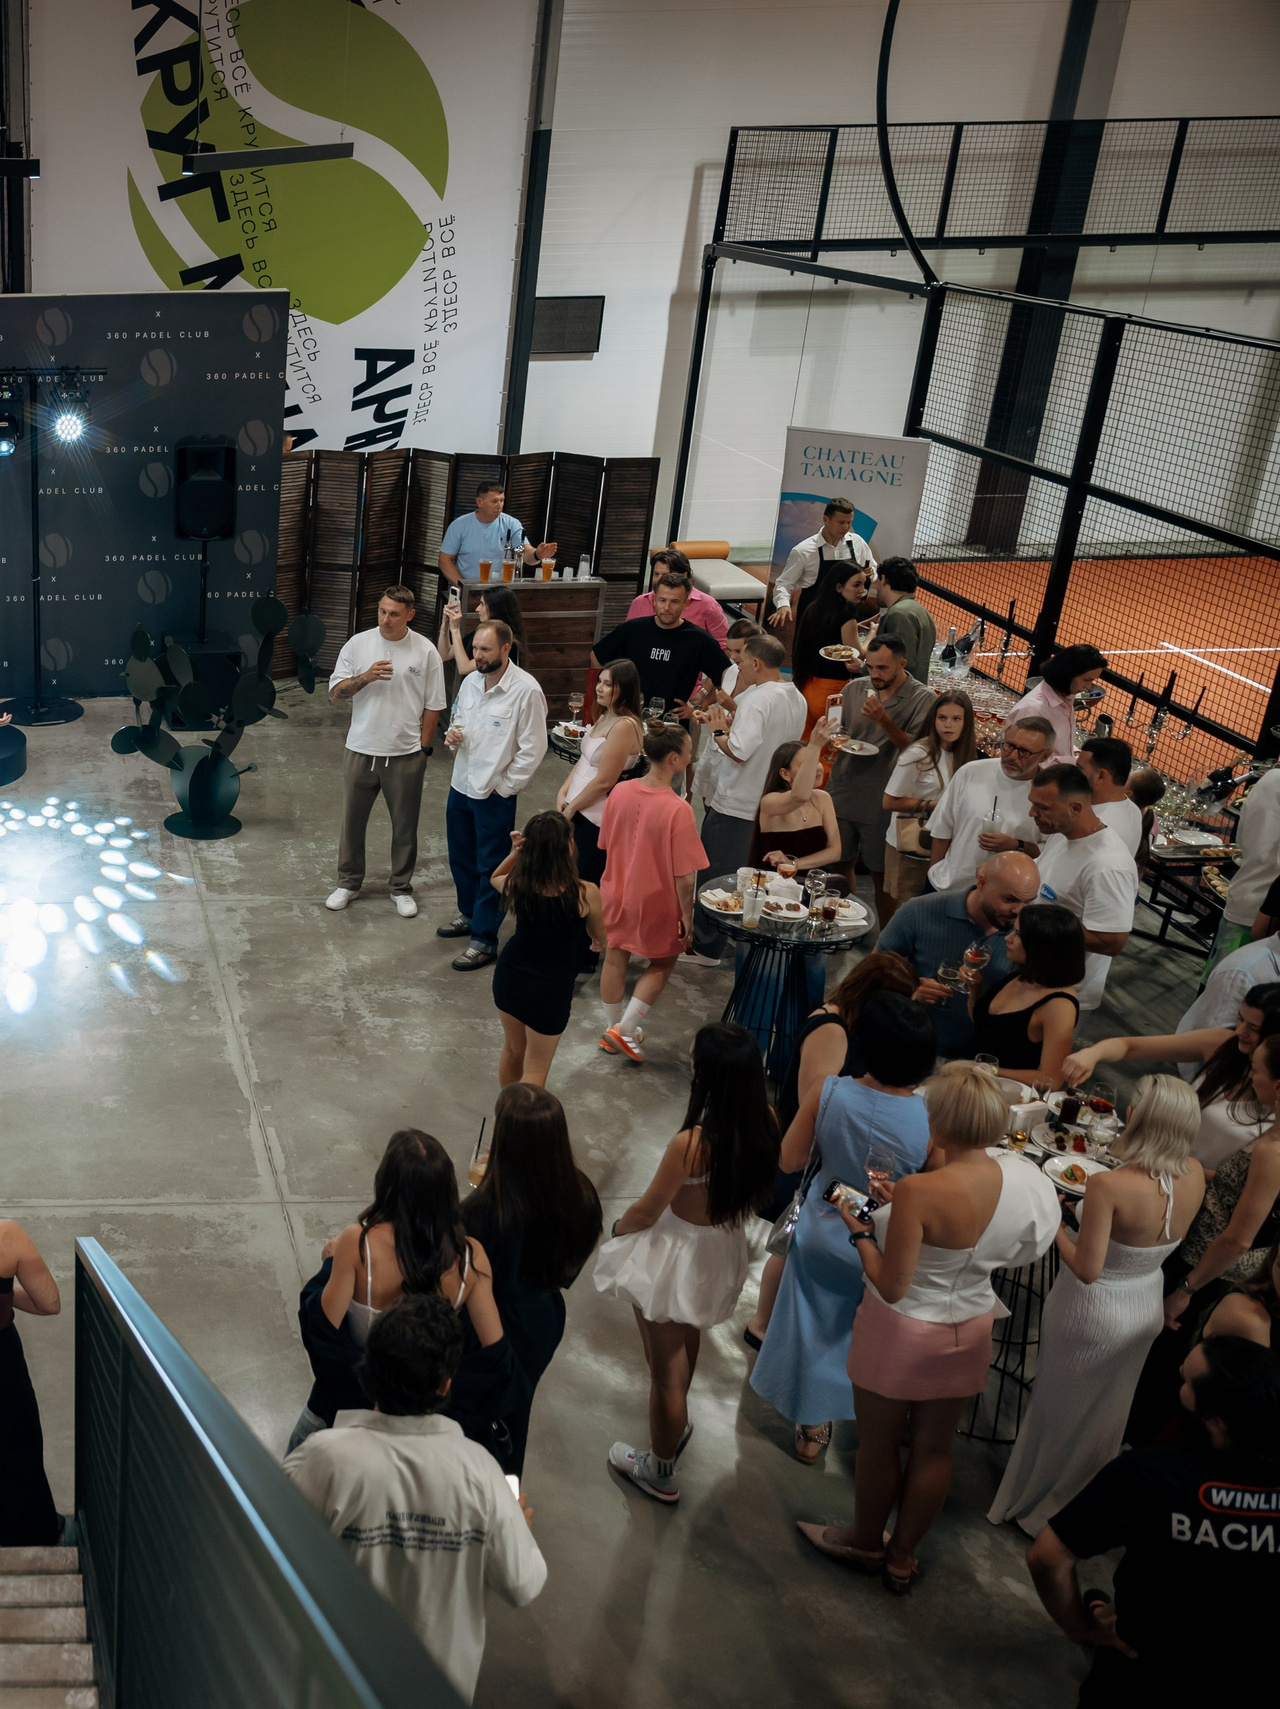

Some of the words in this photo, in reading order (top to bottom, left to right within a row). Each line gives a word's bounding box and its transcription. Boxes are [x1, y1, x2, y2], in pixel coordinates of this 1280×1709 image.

[204, 0, 229, 102] УТИТСЯ
[229, 48, 253, 97] ВСЁ
[238, 105, 278, 233] КРУИТСЯ
[229, 173, 258, 250] ЗДЕСЬ
[252, 259, 273, 289] ВС
[106, 332, 128, 340] 360
[135, 331, 172, 339] PADEL
[179, 330, 210, 339] CLUB
[289, 298, 321, 362] ЗДЕСЬ
[206, 372, 227, 381] 360
[234, 372, 271, 380] PADEL
[287, 329, 322, 404] УТИТСЯ
[105, 446, 126, 454] 360
[133, 445, 169, 453] PADEL
[803, 445, 905, 469] CHATEAU
[800, 462, 904, 487] TAMAGNE
[38, 487, 67, 495] ADEL
[74, 486, 103, 495] CLUB
[237, 484, 266, 492] ADEL
[132, 554, 167, 562] PADEL
[174, 553, 203, 561] CLUB
[39, 594, 67, 602] ADEL
[74, 593, 103, 601] CLUB
[206, 591, 220, 599] 60
[104, 658, 124, 666] 360
[1211, 1487, 1280, 1510] WINLI
[1171, 1512, 1280, 1553] ВАСИ
